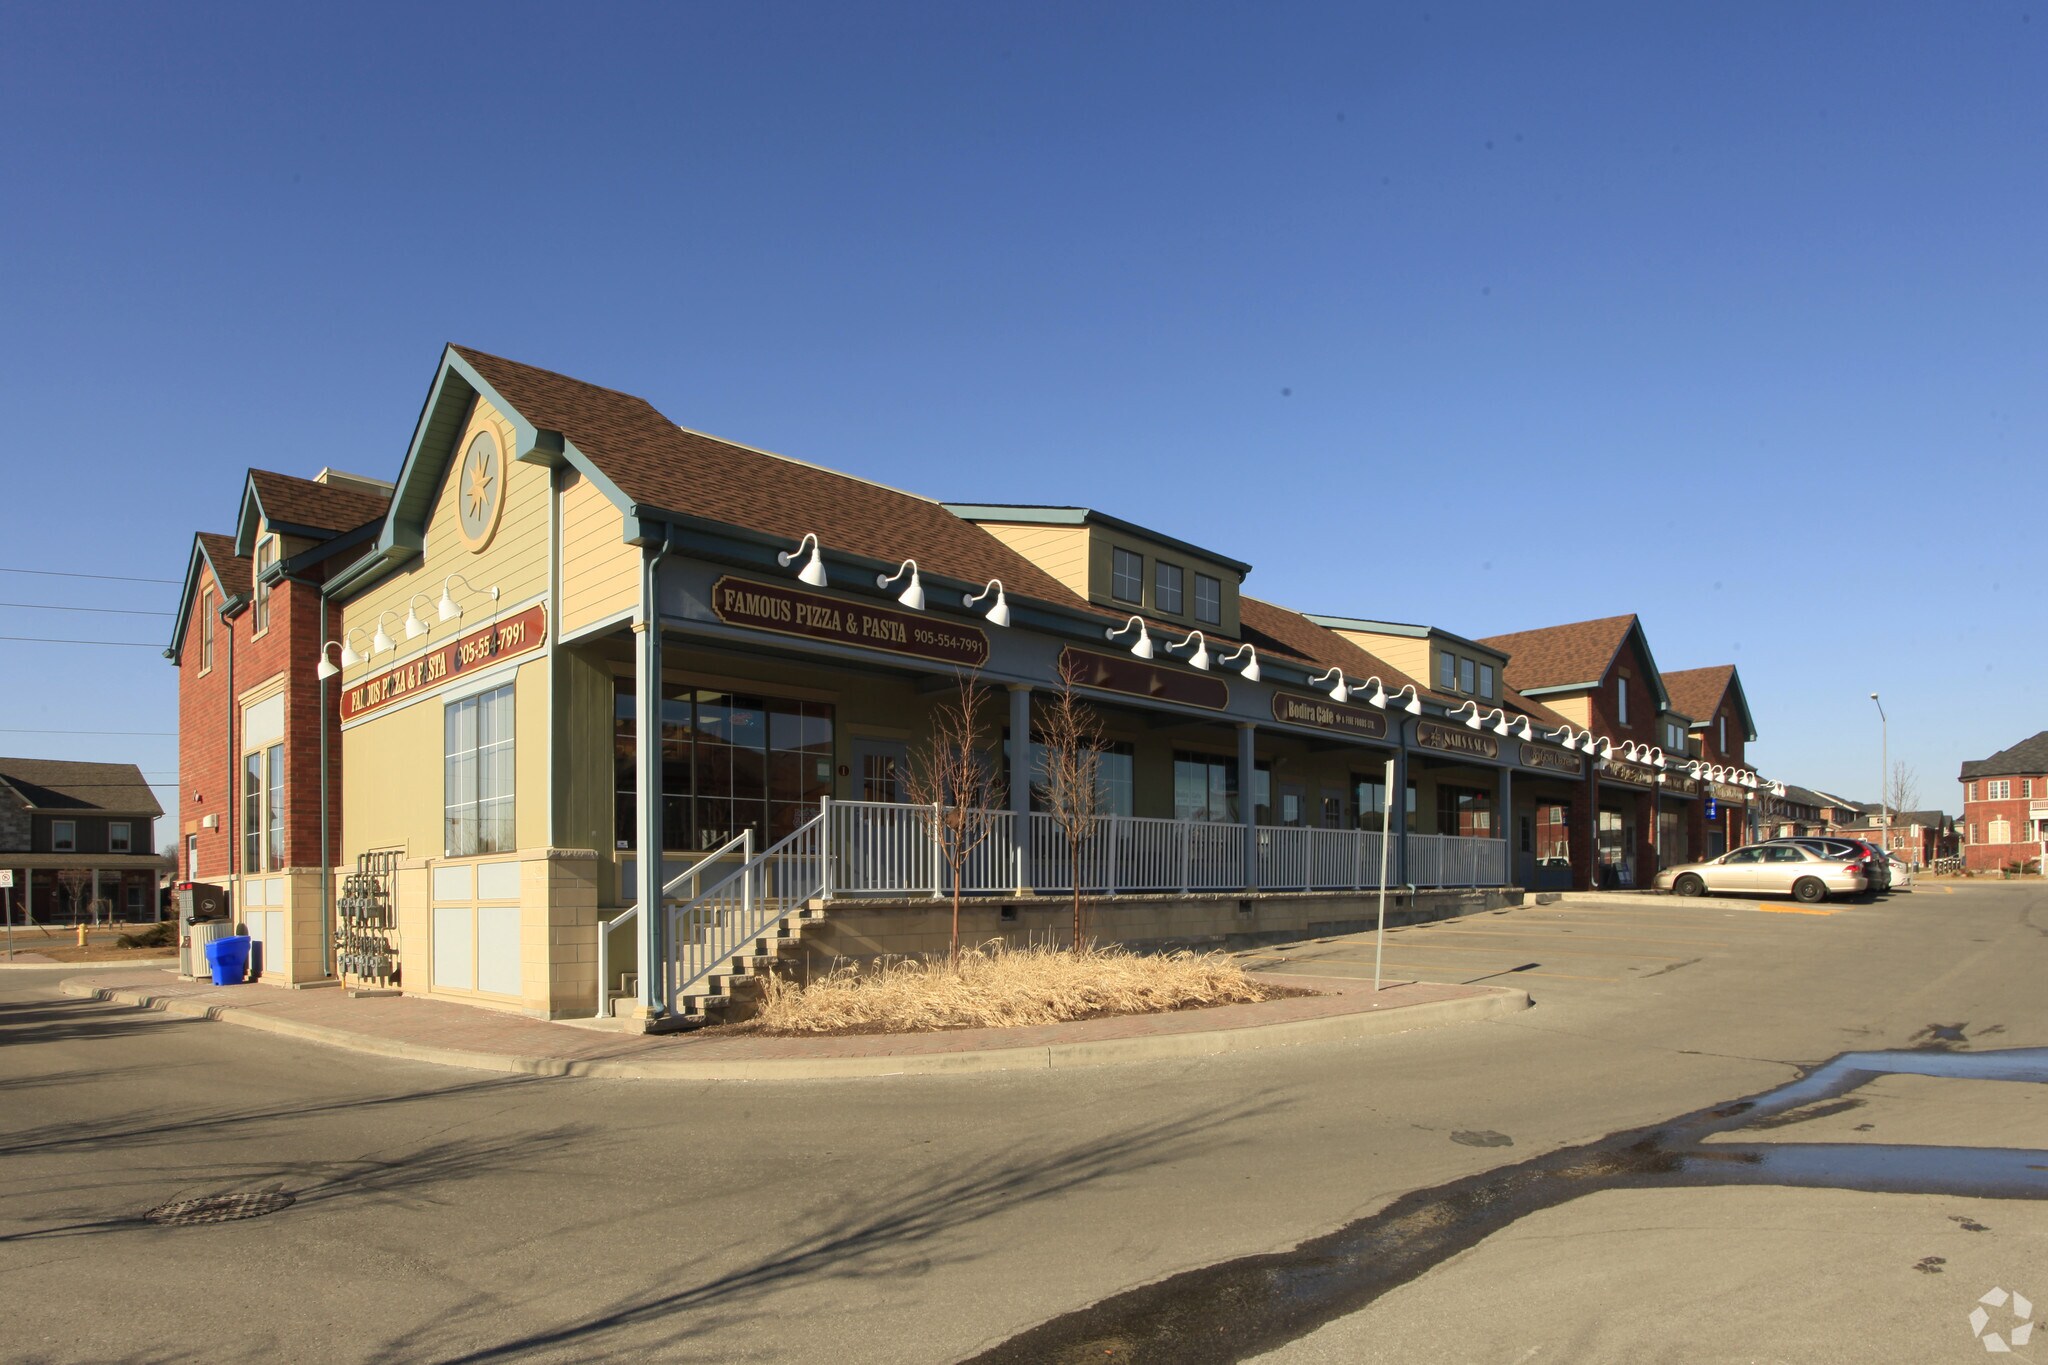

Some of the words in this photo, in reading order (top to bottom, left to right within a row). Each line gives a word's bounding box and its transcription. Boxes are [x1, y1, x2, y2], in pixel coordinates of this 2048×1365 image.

[724, 588, 792, 622] FAMOUS
[796, 602, 842, 632] PIZZA
[846, 612, 858, 635] &
[862, 616, 907, 643] PASTA
[914, 628, 983, 654] 905-554-7991
[381, 669, 406, 701] PIZZA
[407, 665, 416, 690] &
[417, 652, 447, 686] PASTA
[1288, 700, 1316, 722] Bodira
[1316, 705, 1335, 725] Cafe
